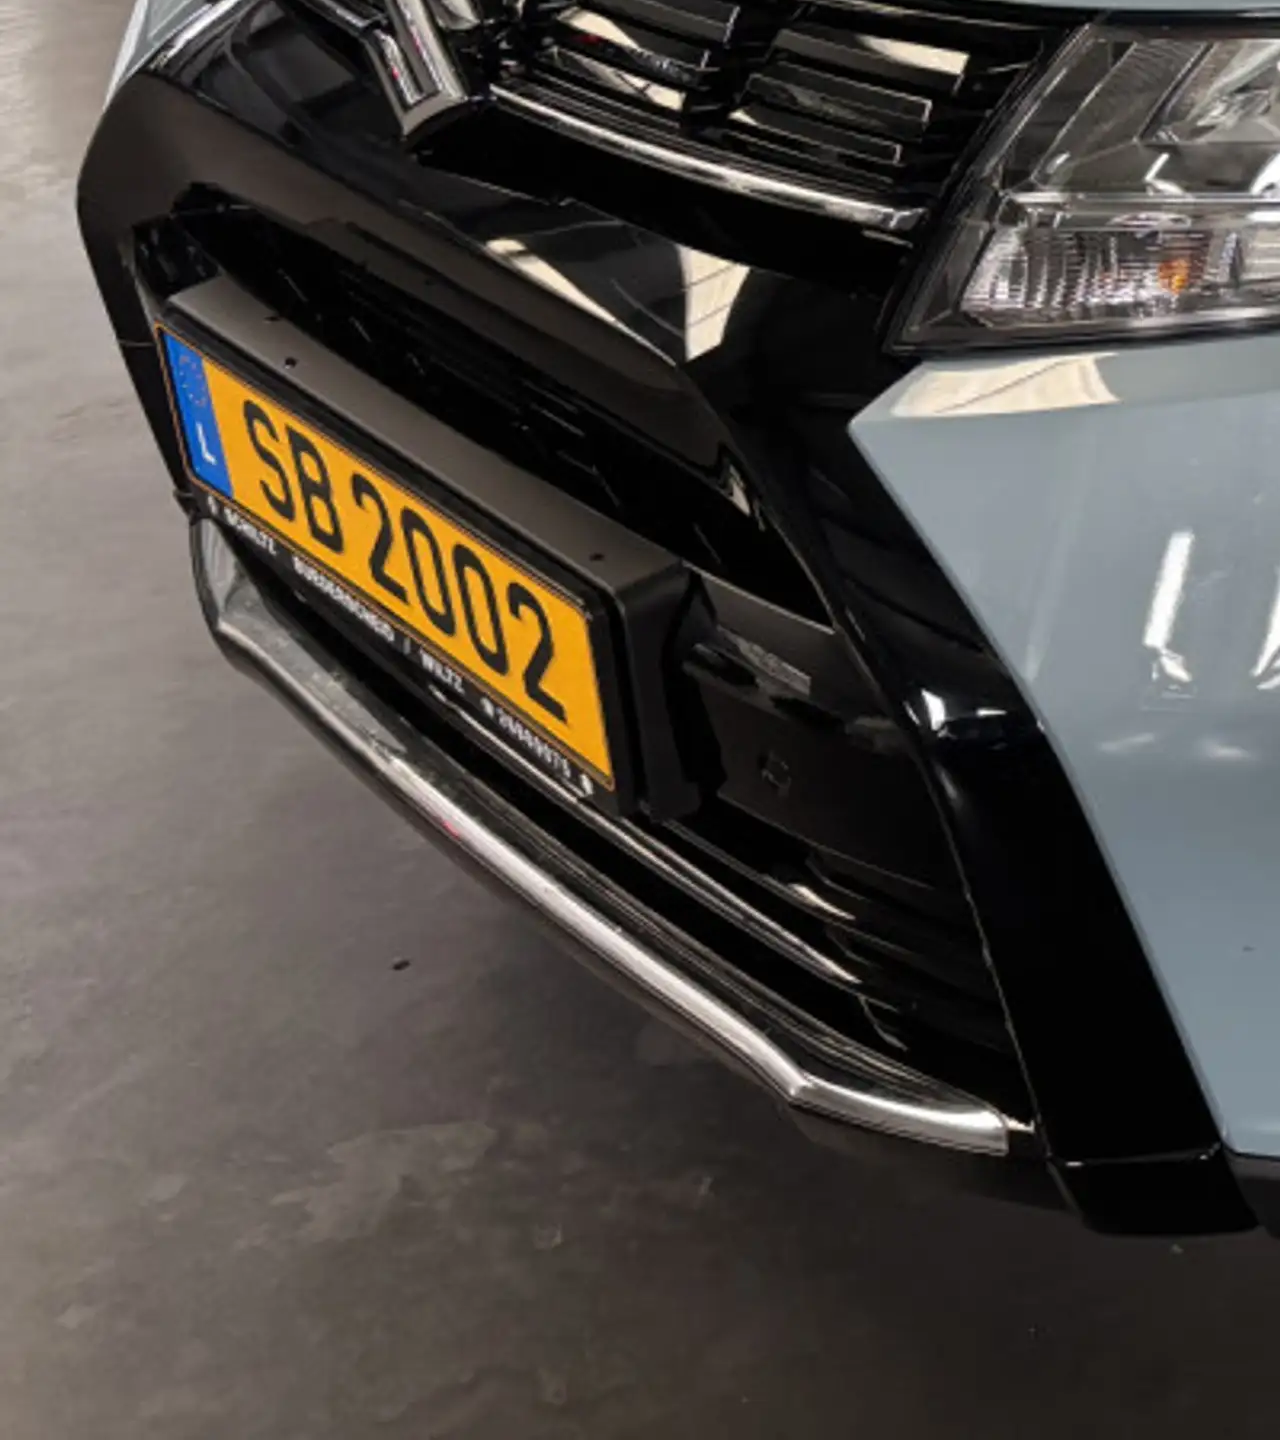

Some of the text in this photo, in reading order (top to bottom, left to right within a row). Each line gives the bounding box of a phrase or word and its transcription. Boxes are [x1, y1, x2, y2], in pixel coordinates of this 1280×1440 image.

[196, 422, 216, 466] L
[243, 398, 344, 555] SB
[351, 472, 568, 725] 2002
